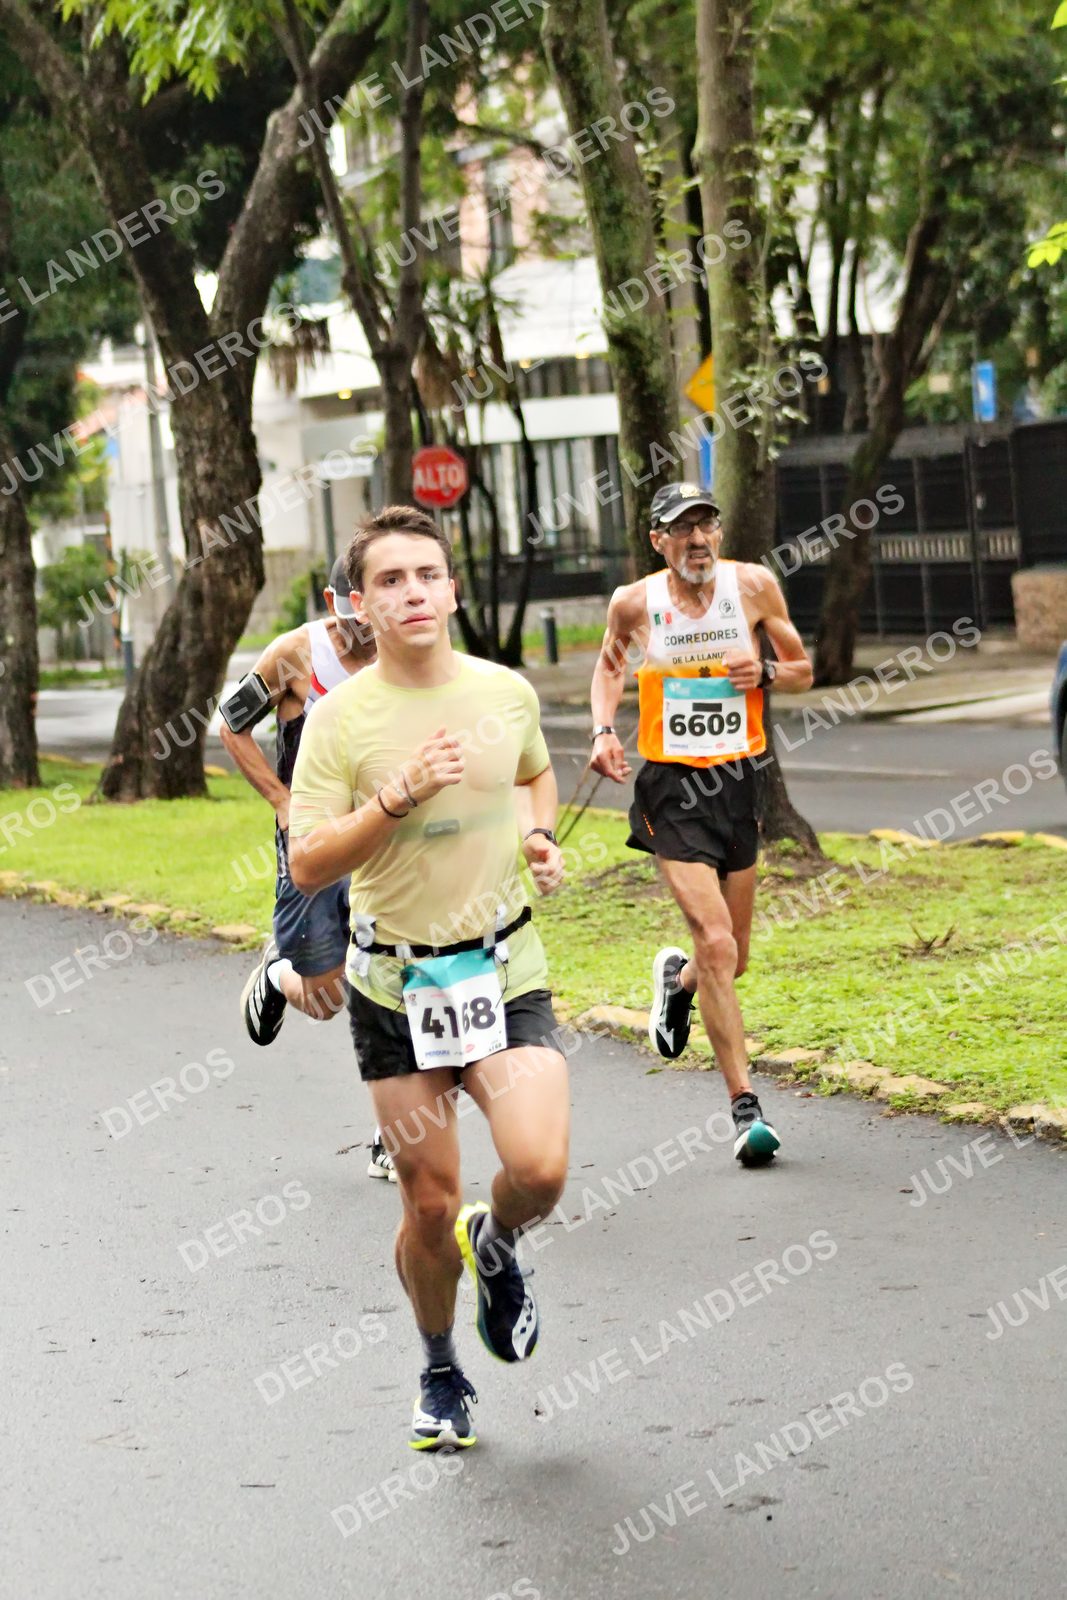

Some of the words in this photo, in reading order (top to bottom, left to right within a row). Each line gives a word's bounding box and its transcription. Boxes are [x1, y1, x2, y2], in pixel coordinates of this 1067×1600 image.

[413, 464, 465, 490] ALTO
[664, 629, 738, 646] CORREDORES
[672, 656, 683, 665] DE
[685, 655, 695, 663] LA
[669, 711, 742, 737] 6609
[421, 997, 497, 1039] 4168
